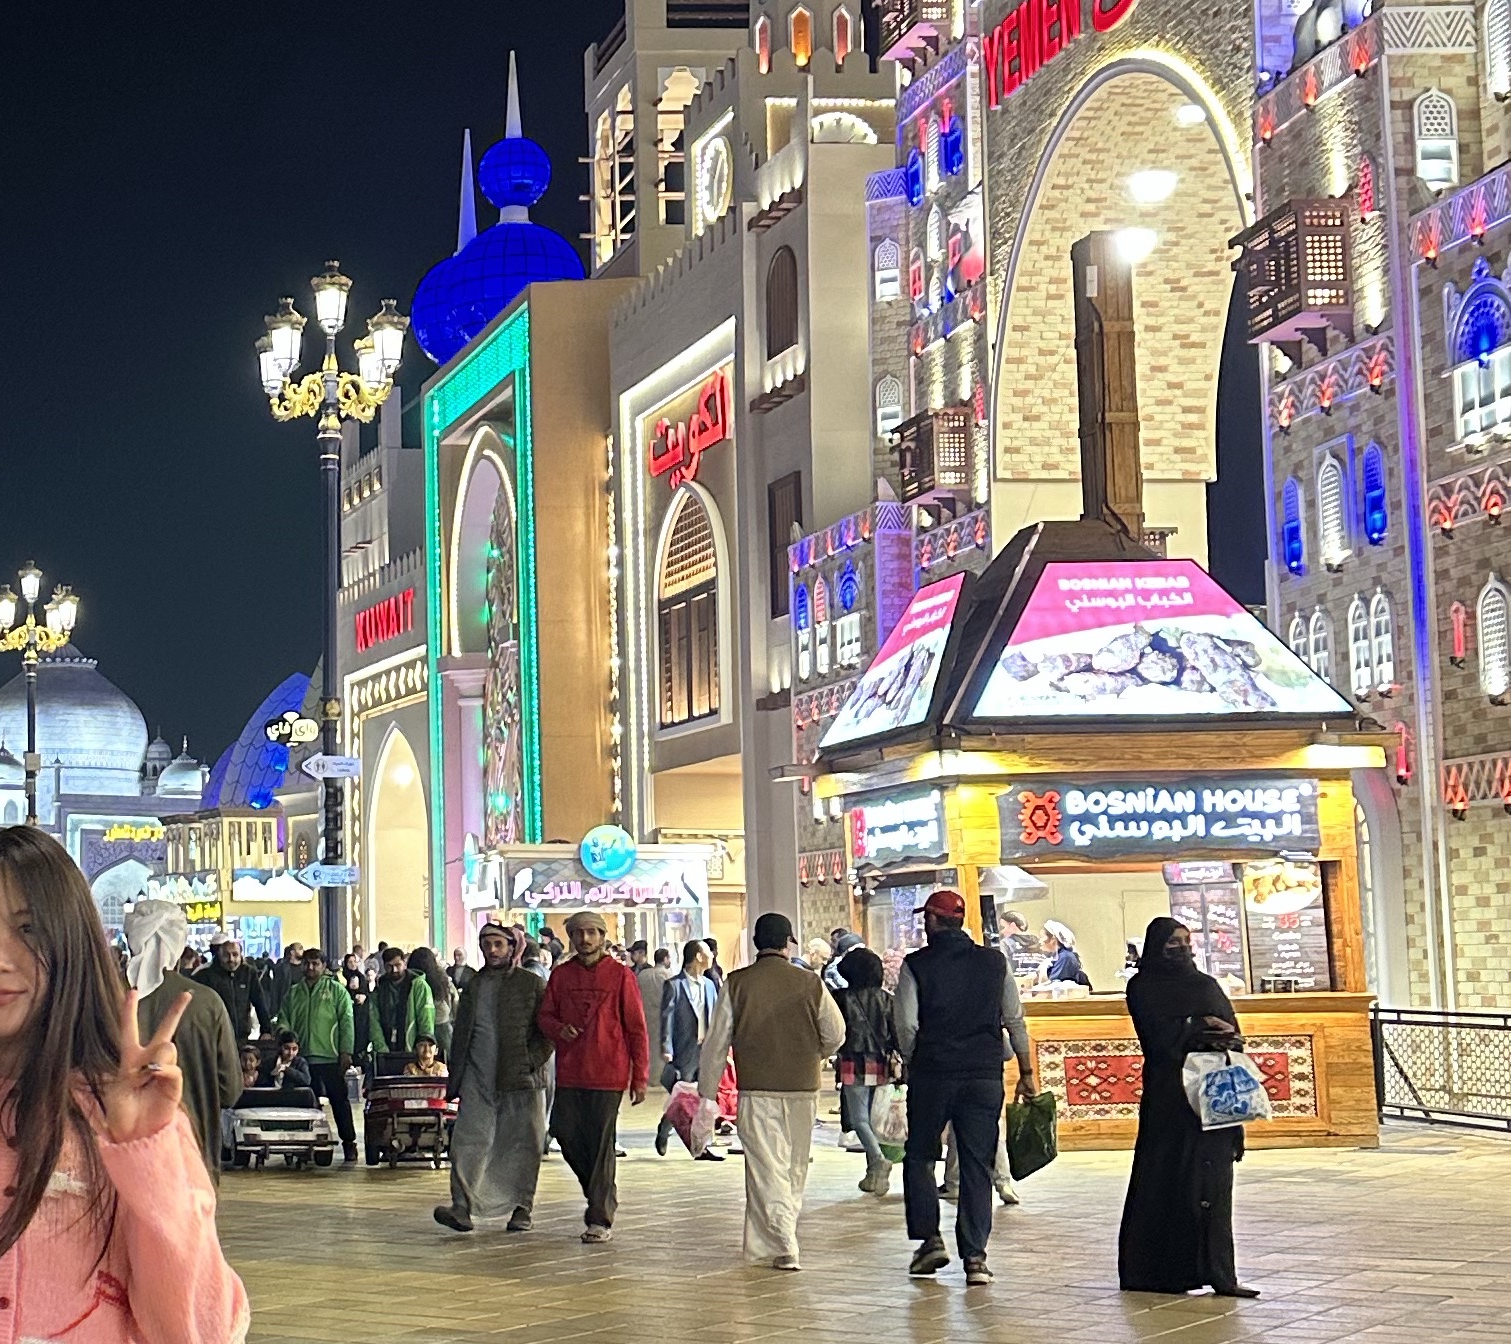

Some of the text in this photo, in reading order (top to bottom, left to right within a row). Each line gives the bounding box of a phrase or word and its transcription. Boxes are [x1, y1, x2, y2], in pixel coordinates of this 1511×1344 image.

[649, 368, 733, 490] الكويت
[355, 587, 415, 654] KUWAIT
[1203, 788, 1301, 813] HOUSE
[1210, 813, 1302, 842] البيت
